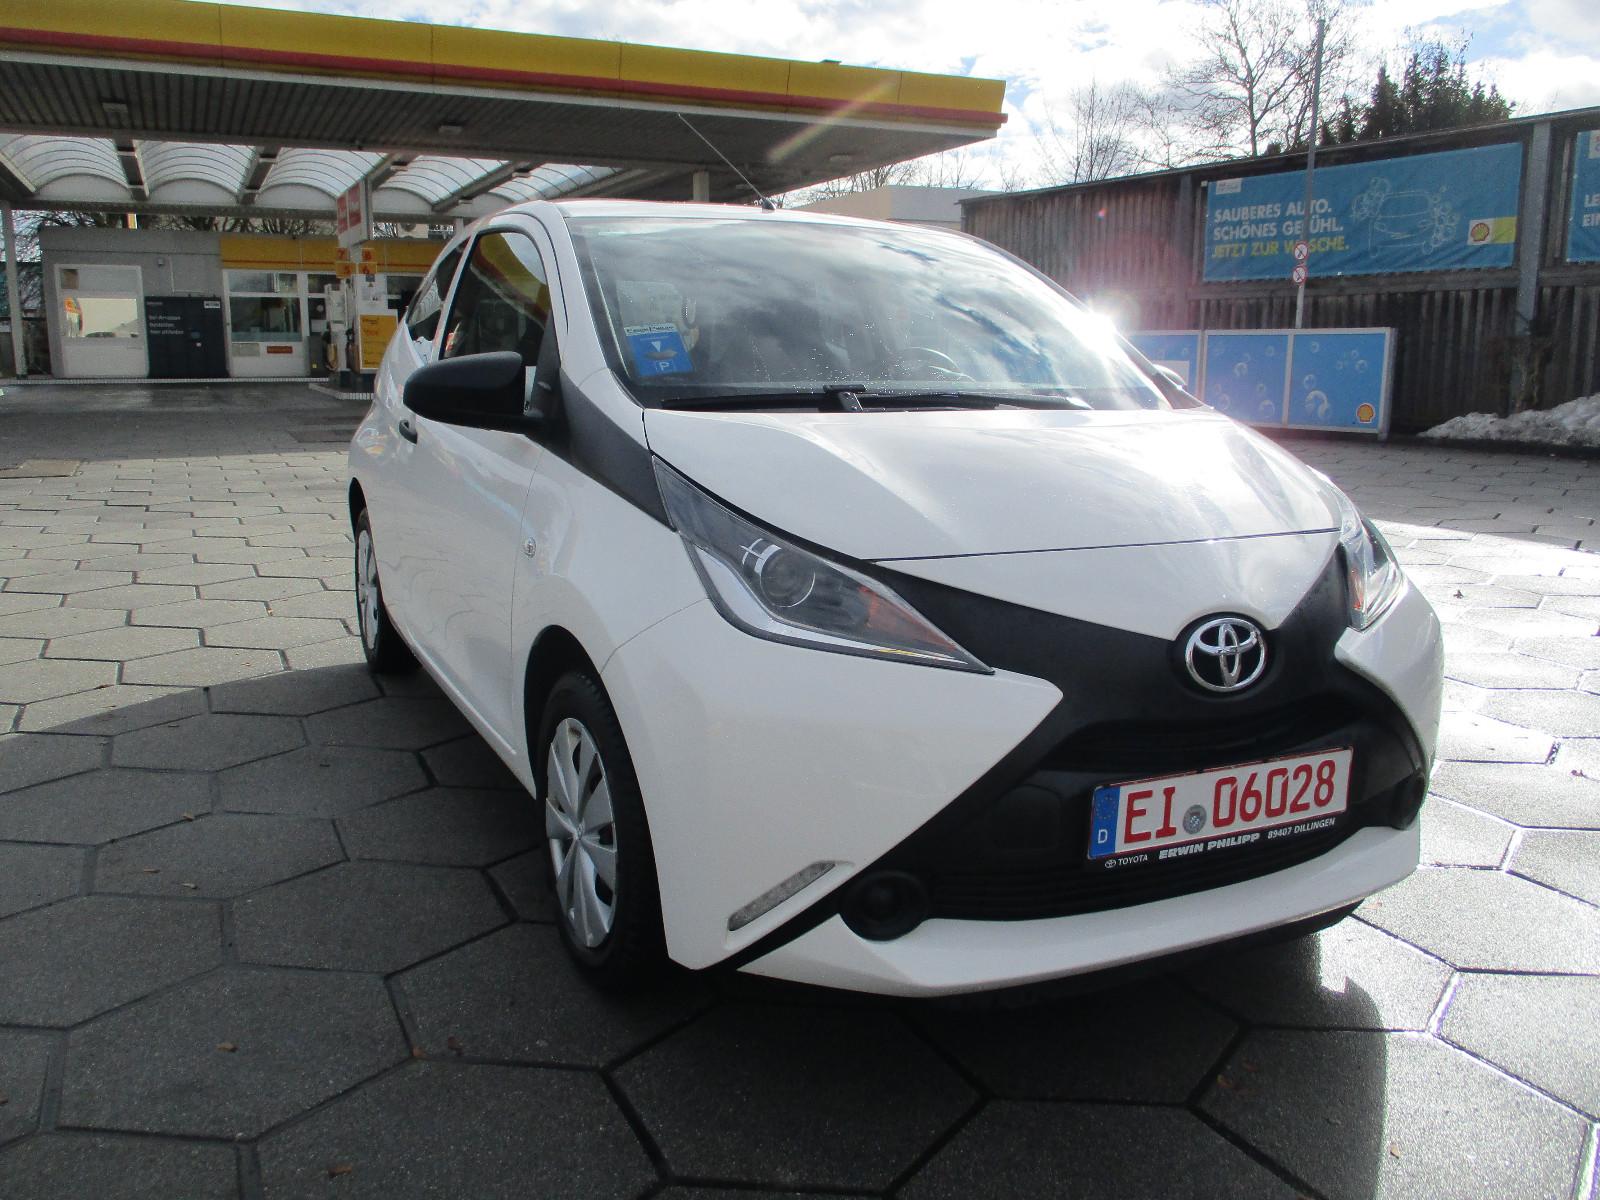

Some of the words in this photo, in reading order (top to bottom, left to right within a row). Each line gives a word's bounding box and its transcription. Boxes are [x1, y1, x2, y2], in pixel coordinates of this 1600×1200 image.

[1213, 203, 1281, 223] SAUBERES
[1213, 221, 1277, 241] SCHÖNES
[1283, 215, 1344, 236] GEÜHL.
[1211, 241, 1247, 258] JETZT
[1251, 240, 1279, 256] ZUR
[1284, 236, 1349, 254] WSCHE.
[659, 361, 670, 371] P
[1123, 786, 1177, 844] EI
[1212, 759, 1336, 828] 06028
[1097, 829, 1108, 844] D
[1118, 853, 1148, 867] TOYOTA
[1158, 842, 1204, 860] ERWIN
[1206, 832, 1260, 851] PHILIPP
[1267, 827, 1293, 839] 89407
[1294, 817, 1337, 834] DILLINGEN
